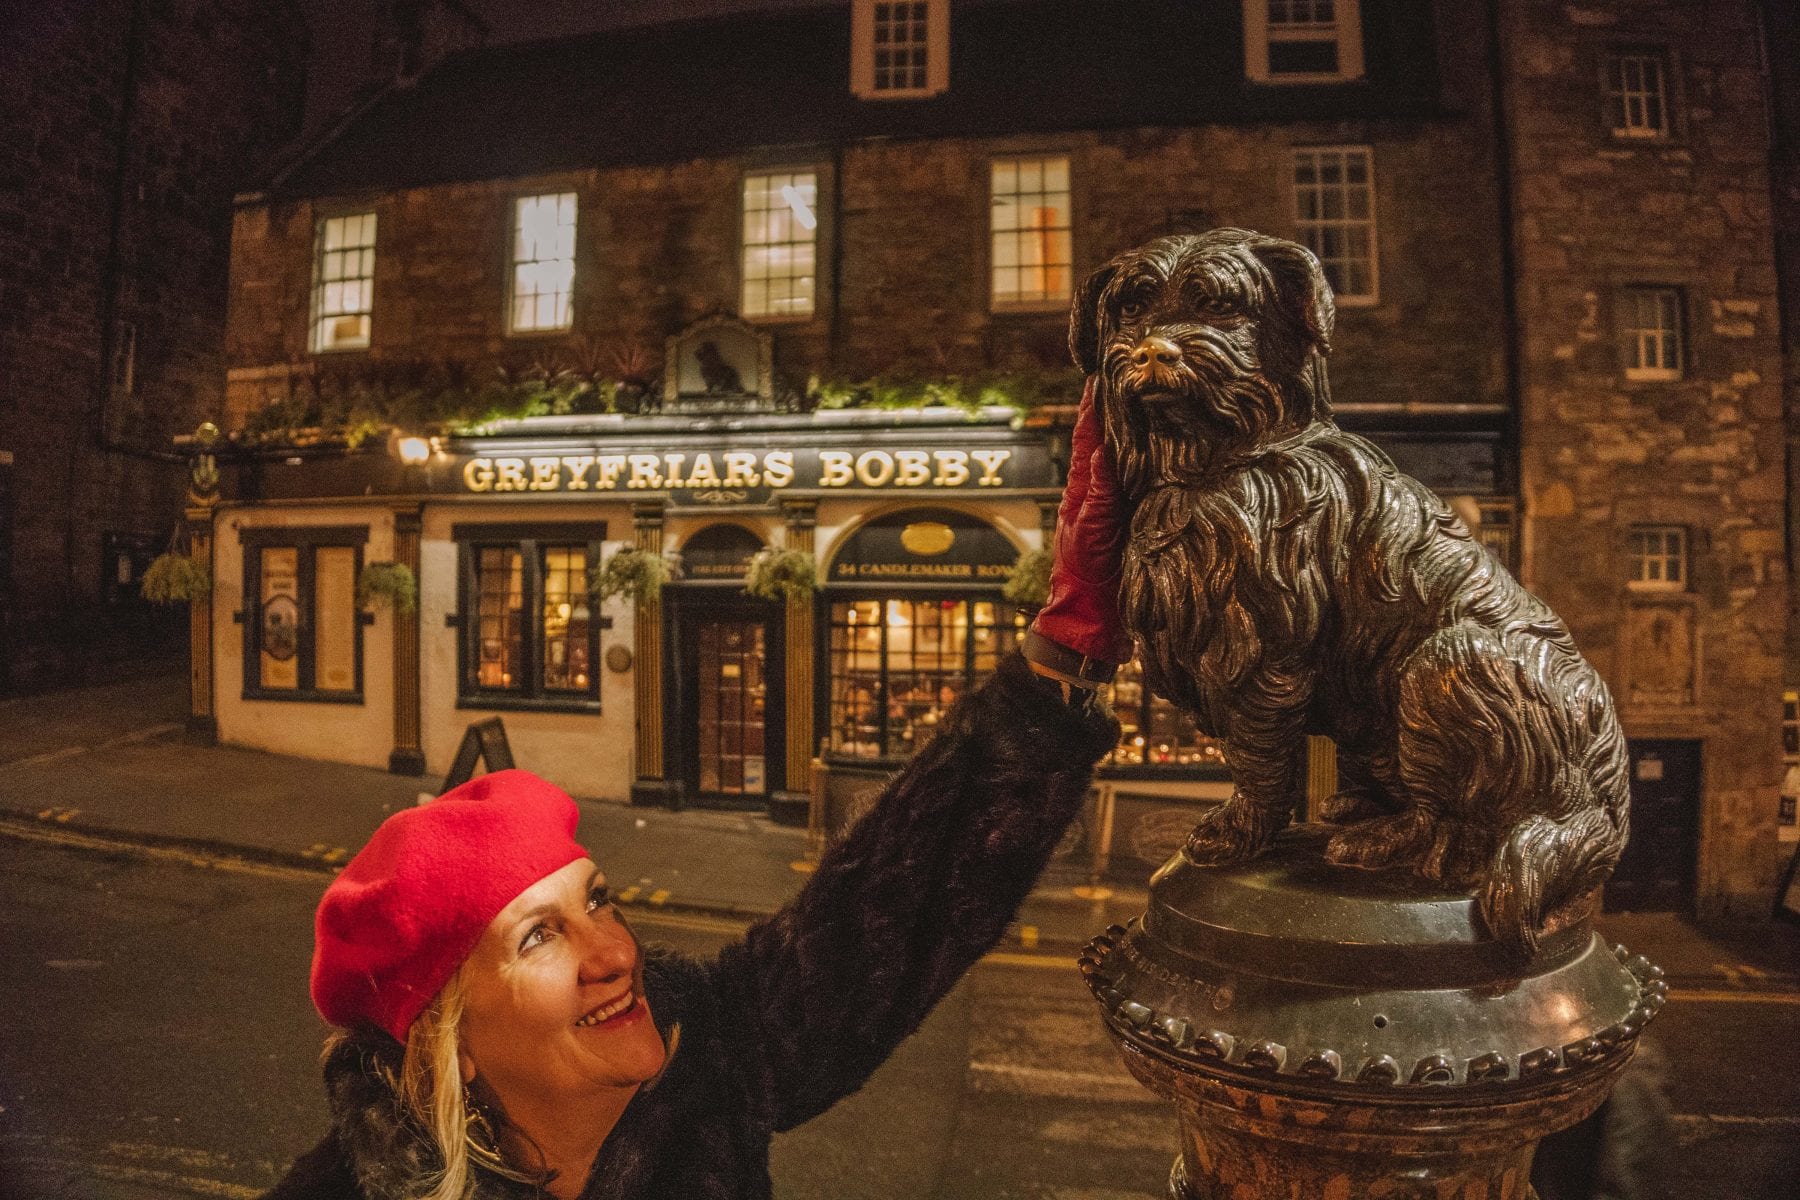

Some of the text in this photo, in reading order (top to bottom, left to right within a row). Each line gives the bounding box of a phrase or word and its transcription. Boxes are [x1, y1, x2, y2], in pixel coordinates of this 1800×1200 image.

[463, 450, 1011, 492] GREYFRIARS BOBBY
[860, 563, 972, 577] CANDLEMAKER
[976, 564, 1015, 577] ROW
